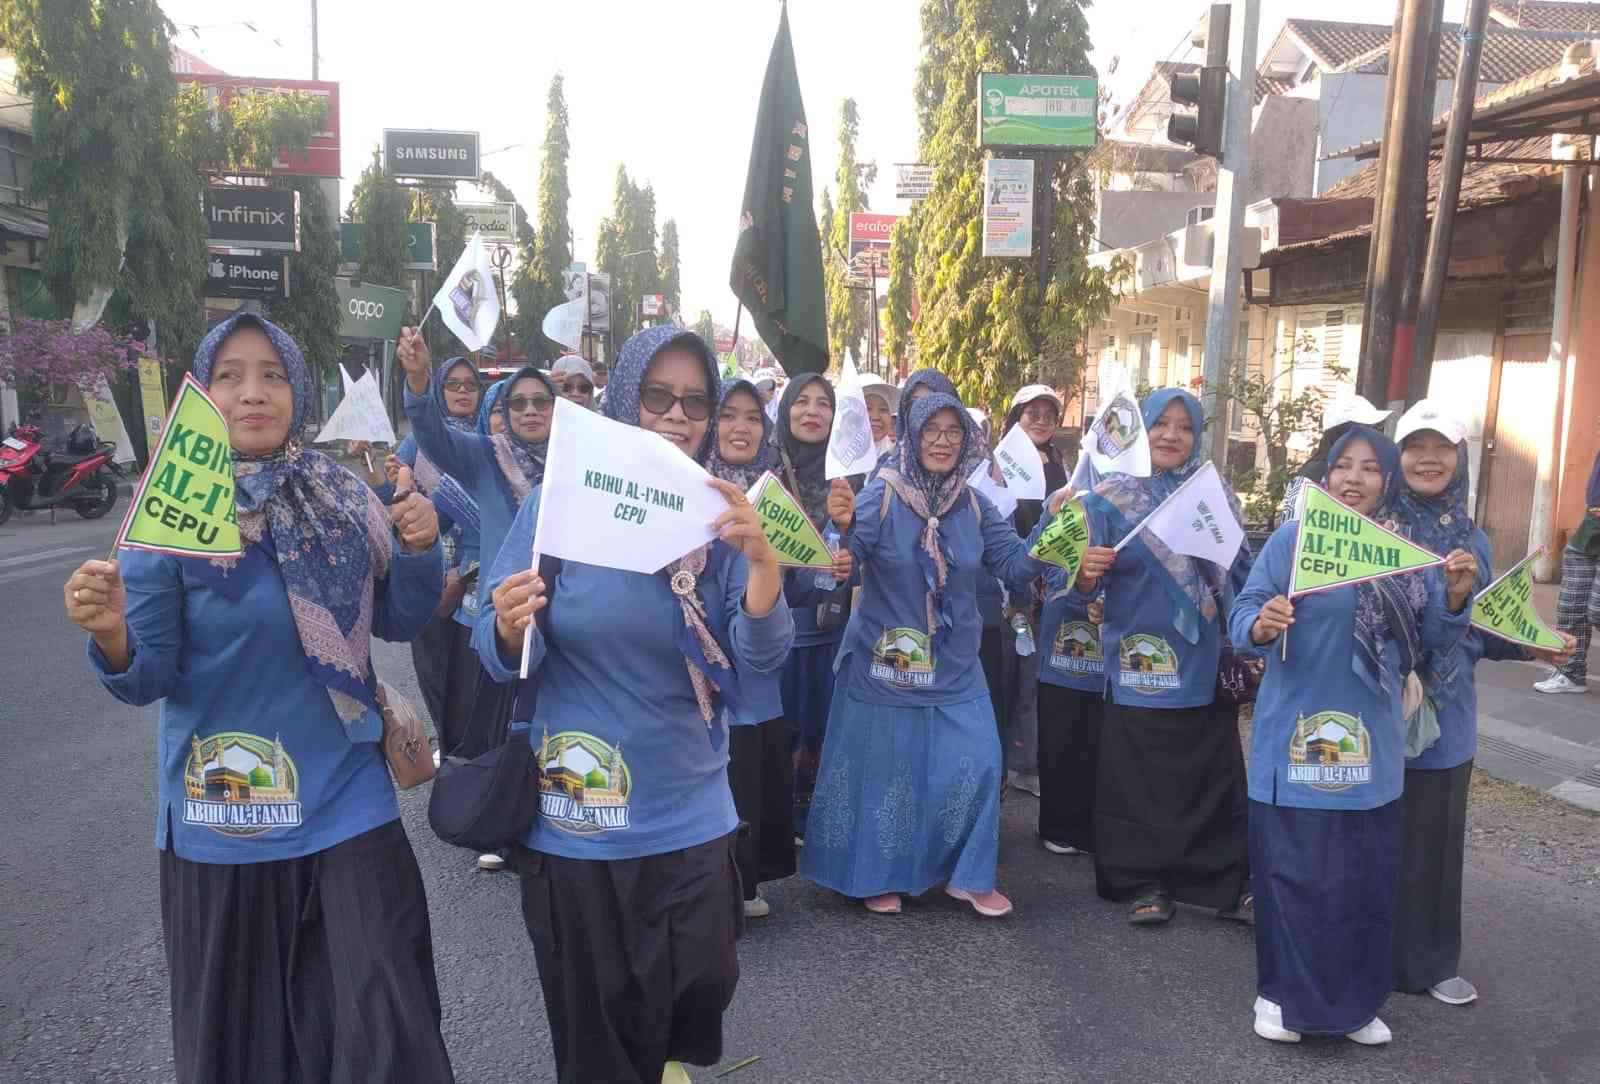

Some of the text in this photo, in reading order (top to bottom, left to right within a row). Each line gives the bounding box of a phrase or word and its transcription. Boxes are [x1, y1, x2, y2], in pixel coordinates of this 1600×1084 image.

[1019, 84, 1080, 97] APOTEK
[395, 146, 468, 160] SAMSUNG
[211, 205, 285, 225] Infinix
[229, 264, 279, 280] iPhone
[167, 423, 232, 478] KBIH
[584, 469, 685, 512] KBIHU AL-I'ANAH
[144, 496, 220, 545] CEPU
[613, 502, 647, 525] CEPU
[757, 497, 805, 533] KBIHU
[1305, 508, 1360, 535] KBIHU
[1302, 533, 1400, 568] AL-I'ANAH
[1300, 557, 1348, 577] CEPU
